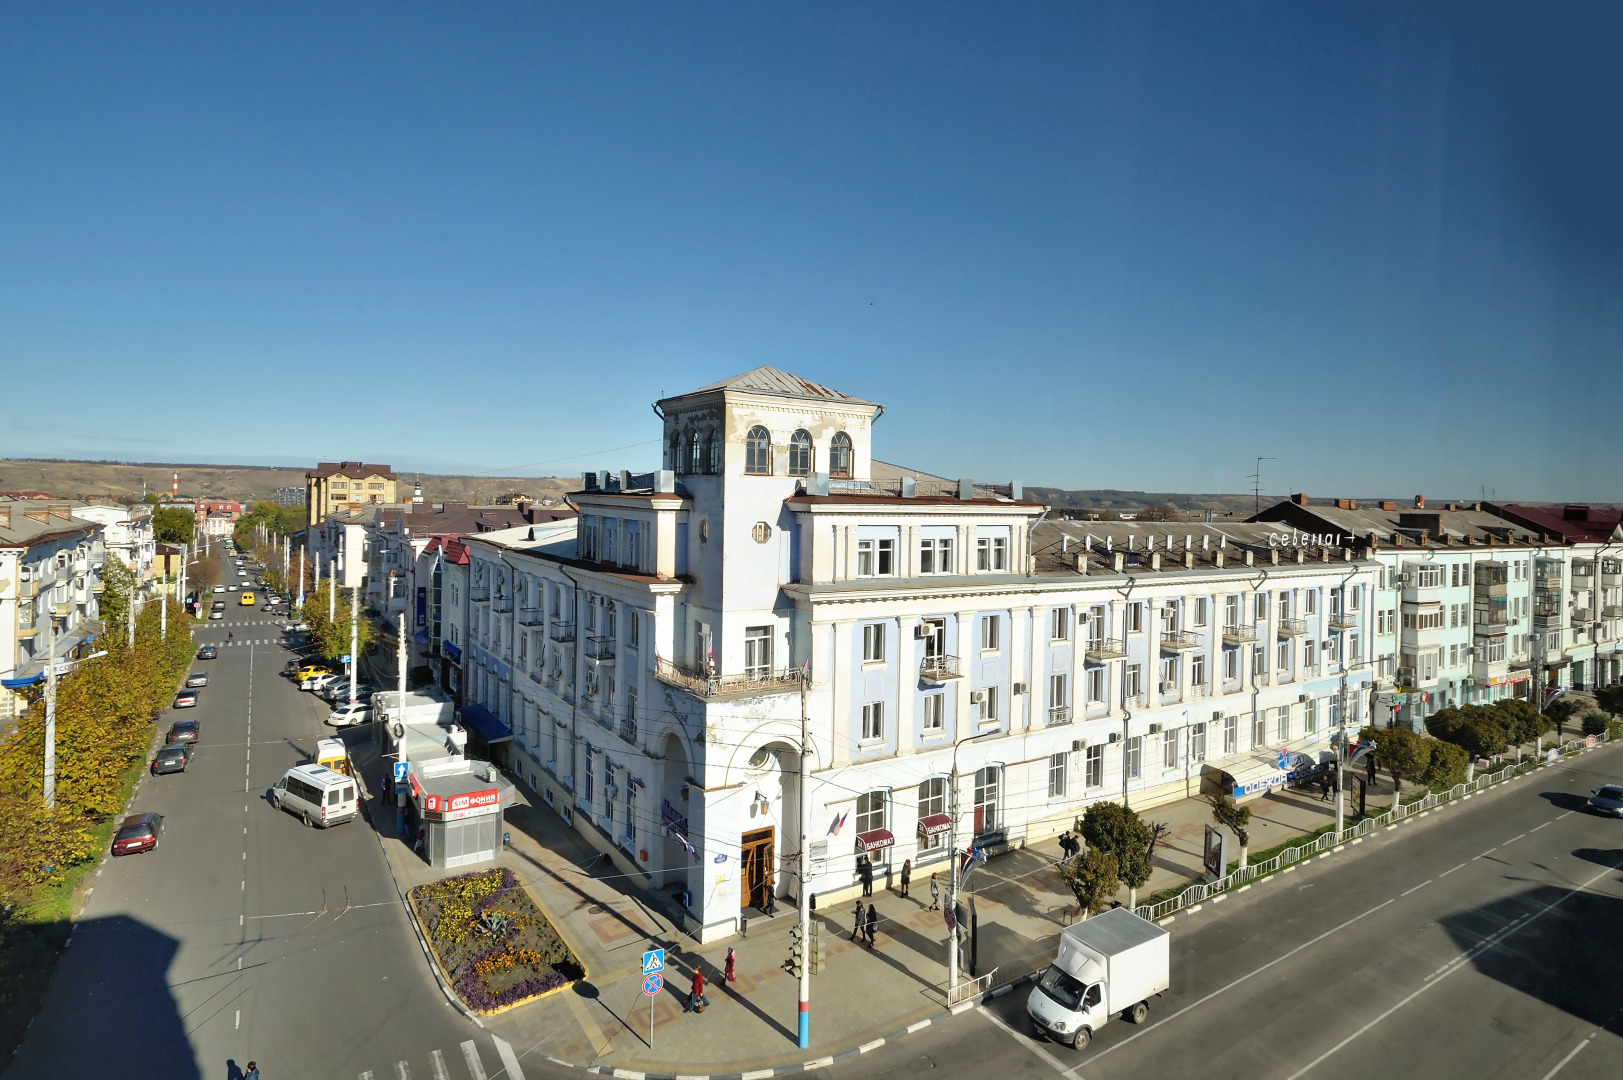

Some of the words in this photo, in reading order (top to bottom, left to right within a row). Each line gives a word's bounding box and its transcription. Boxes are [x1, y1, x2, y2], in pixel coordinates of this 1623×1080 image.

[1063, 535, 1226, 552] ГОСТИНИЦА
[1244, 773, 1288, 795] ОДЕЖДА
[453, 799, 468, 808] SIM
[866, 837, 894, 850] БАНКОМАТ
